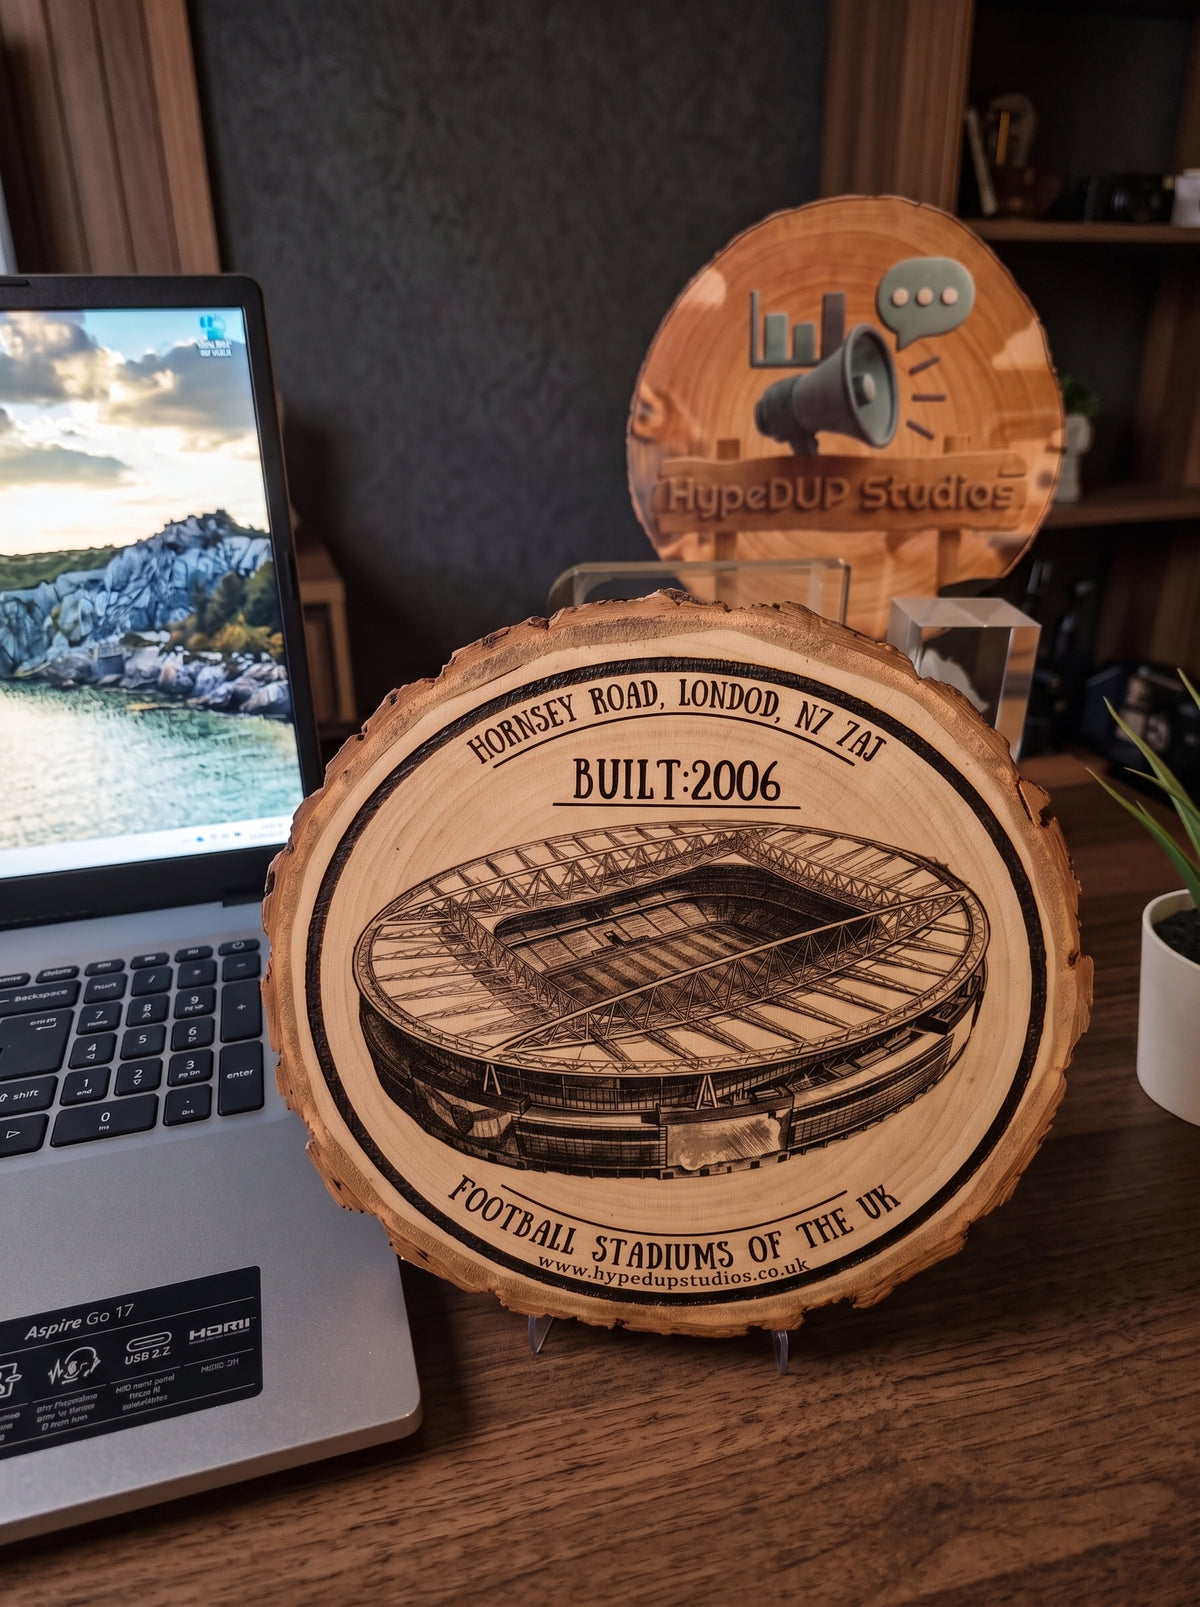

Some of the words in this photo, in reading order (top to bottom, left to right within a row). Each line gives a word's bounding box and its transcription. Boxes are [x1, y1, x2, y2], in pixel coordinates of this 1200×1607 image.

[669, 476, 850, 518] HypeDUP
[860, 474, 1014, 513] Studios
[466, 694, 578, 765] HORNSEY
[588, 679, 665, 715] ROAD,
[190, 995, 199, 1004] 9
[143, 1003, 152, 1012] 8
[95, 1011, 104, 1020] 7
[188, 1027, 197, 1036] 6
[138, 1034, 147, 1044] 5
[87, 1043, 97, 1053] 4
[186, 1060, 196, 1070] 3
[134, 1069, 144, 1079] 2
[226, 1069, 254, 1080] enter
[83, 1078, 90, 1087] 1
[12, 1088, 39, 1100] shift
[100, 1112, 111, 1123] 0
[447, 1175, 577, 1257] FOOTBALL
[591, 1235, 735, 1272] STADIUMS
[748, 1230, 783, 1264] OF
[795, 1206, 855, 1250] THE
[855, 1183, 902, 1219] UK
[538, 1254, 811, 1291] www.hypedupstudios.co.uk
[24, 1316, 82, 1341] Aspire
[86, 1311, 110, 1326] Go
[115, 1303, 135, 1319] 17
[124, 1351, 150, 1366] USB
